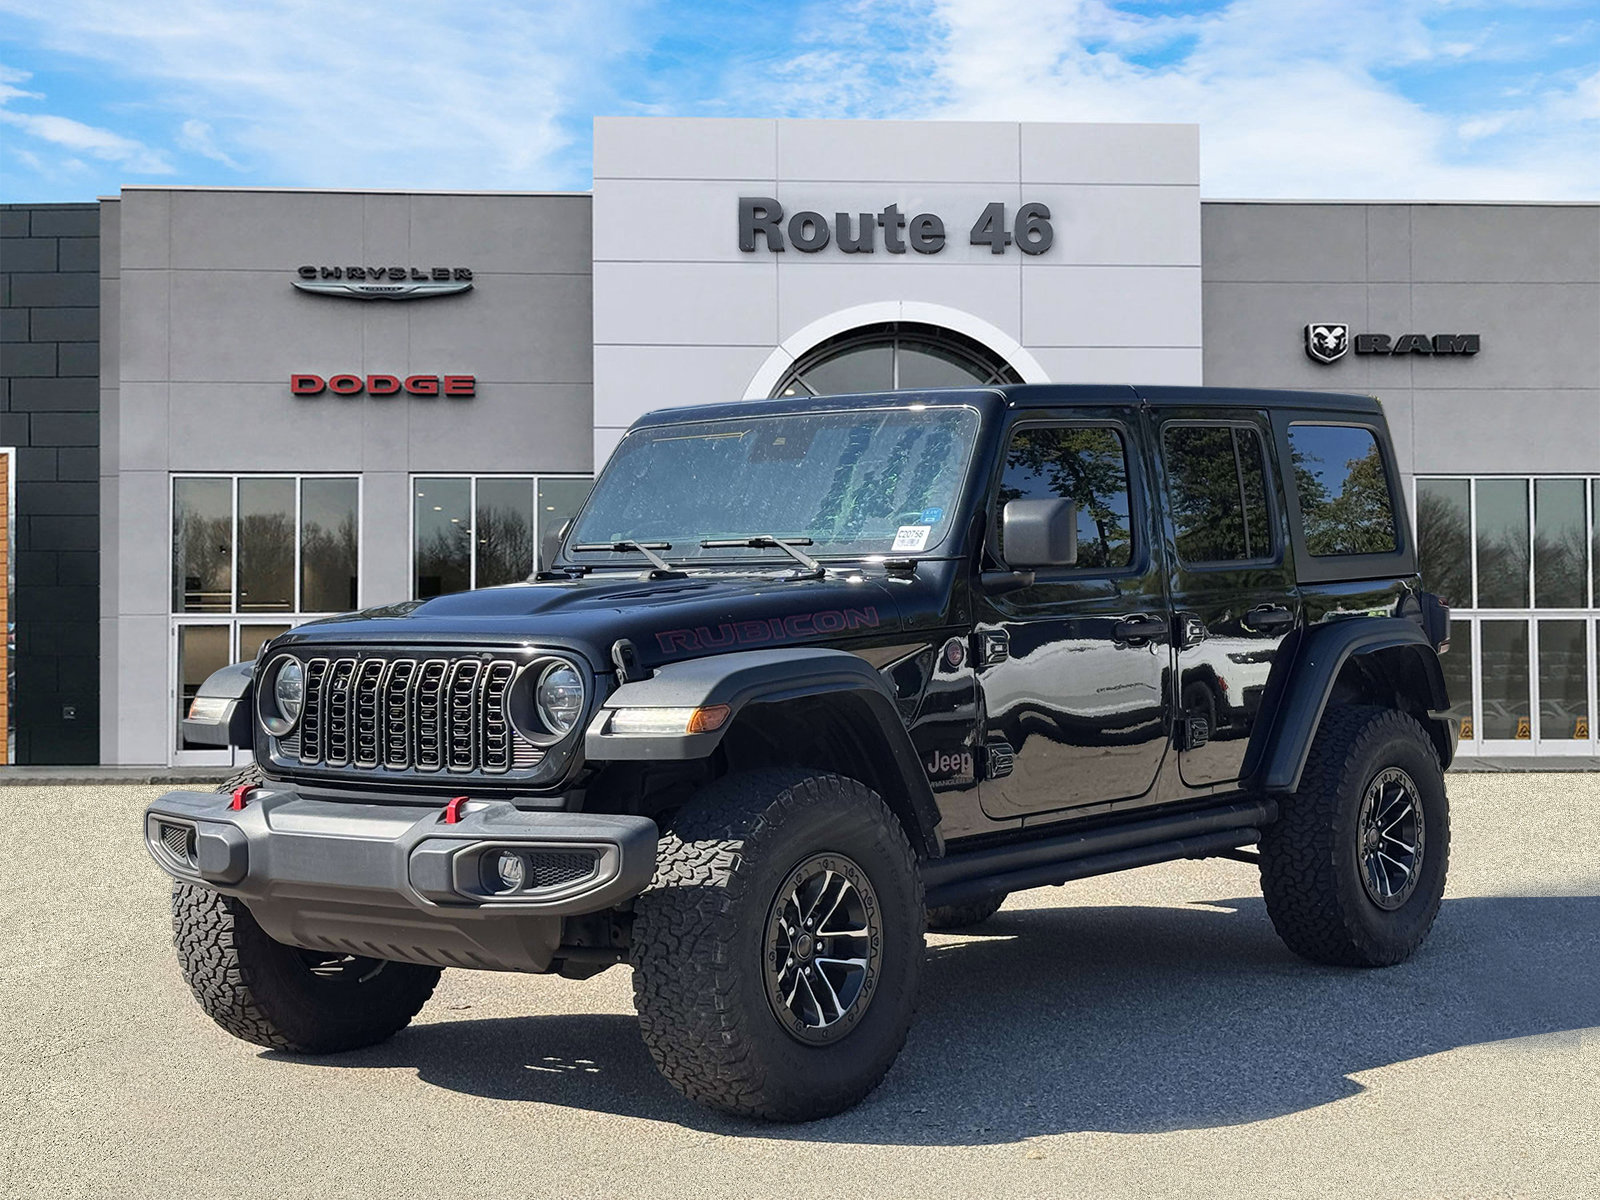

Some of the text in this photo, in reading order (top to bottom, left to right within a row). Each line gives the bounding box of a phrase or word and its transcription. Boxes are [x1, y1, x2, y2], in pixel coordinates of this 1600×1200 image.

[738, 196, 1054, 255] Route 46
[298, 266, 473, 280] CHRYSLER
[1354, 333, 1480, 356] RAM
[291, 374, 476, 397] DODGE
[655, 606, 880, 654] RUBICON
[928, 750, 972, 774] Jeep
